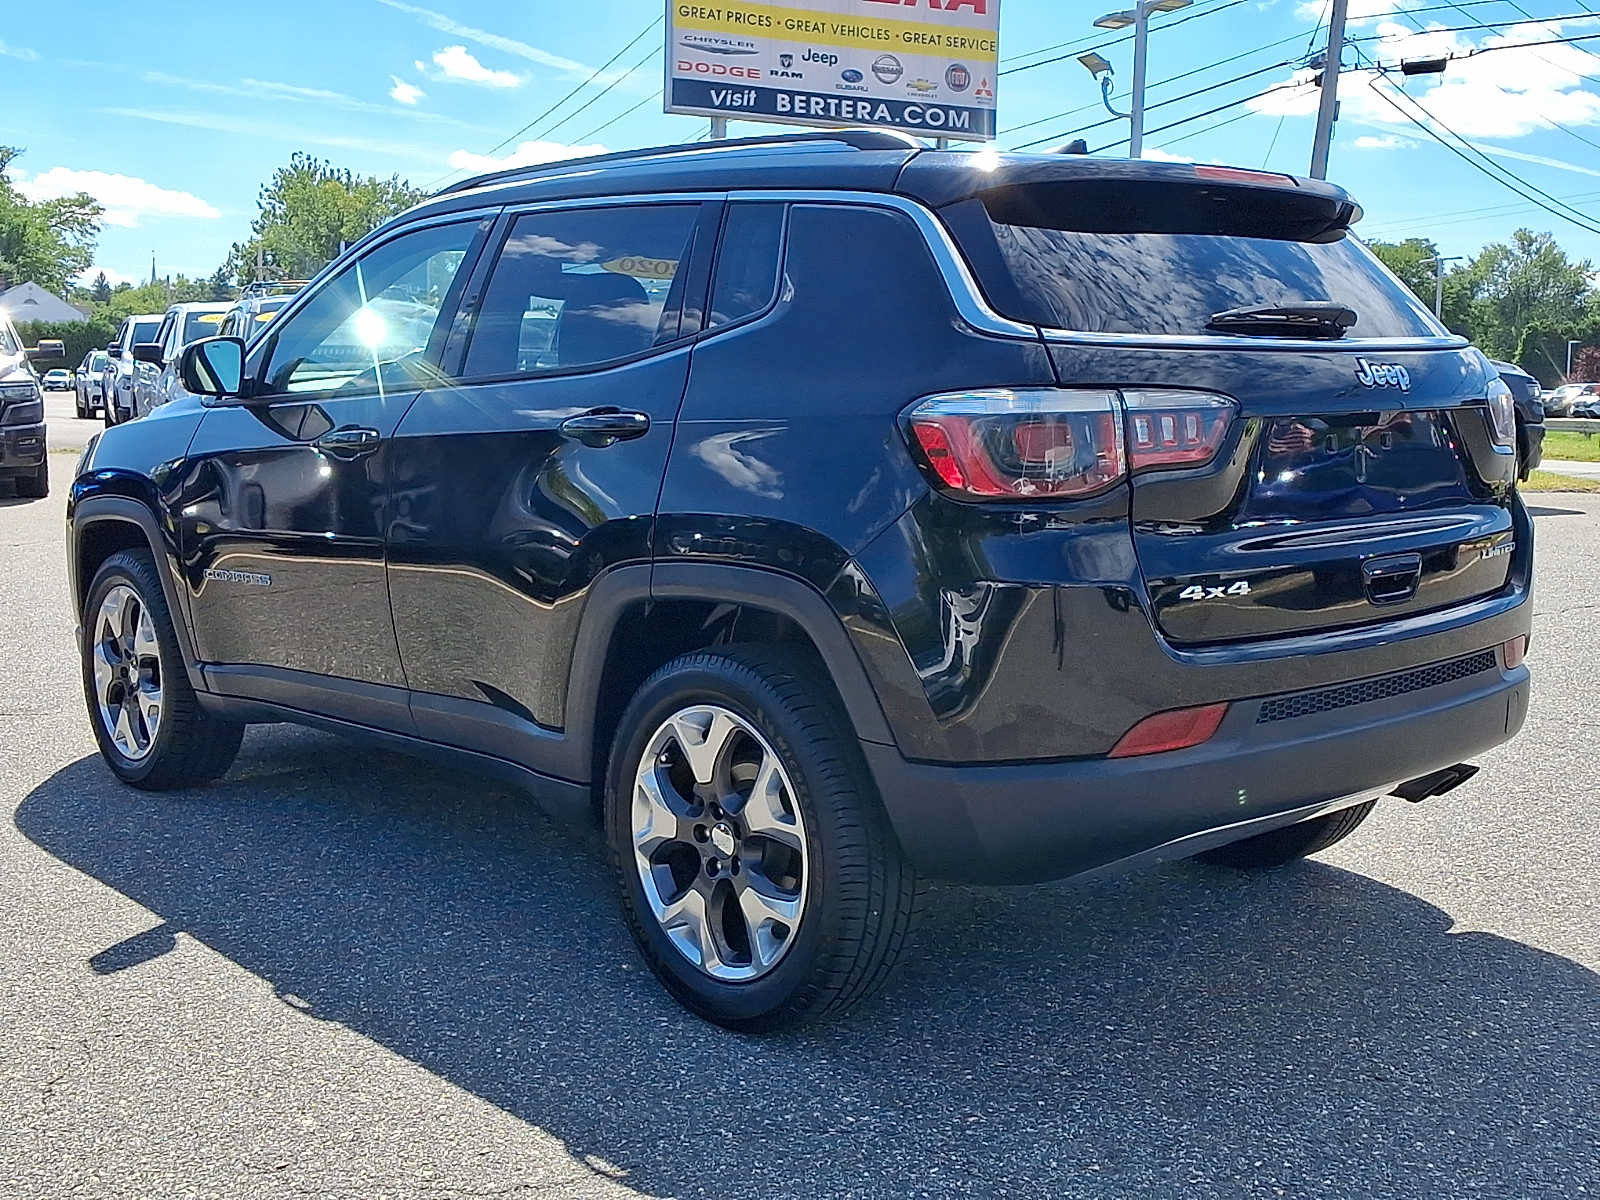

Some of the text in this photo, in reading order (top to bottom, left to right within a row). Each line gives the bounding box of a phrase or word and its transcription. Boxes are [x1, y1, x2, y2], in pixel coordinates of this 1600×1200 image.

[679, 5, 996, 52] GREAT PRICES GREAT VEHICLES GREAT SERVICE
[683, 35, 755, 48] CHRYSLER
[801, 48, 839, 67] Jeep
[677, 60, 761, 79] DODGE
[769, 69, 803, 79] RAM
[835, 83, 869, 92] SUBARU
[710, 89, 970, 129] Visit BERTERA.COM
[1354, 355, 1411, 392] Jeep
[1179, 581, 1252, 601] 4x4
